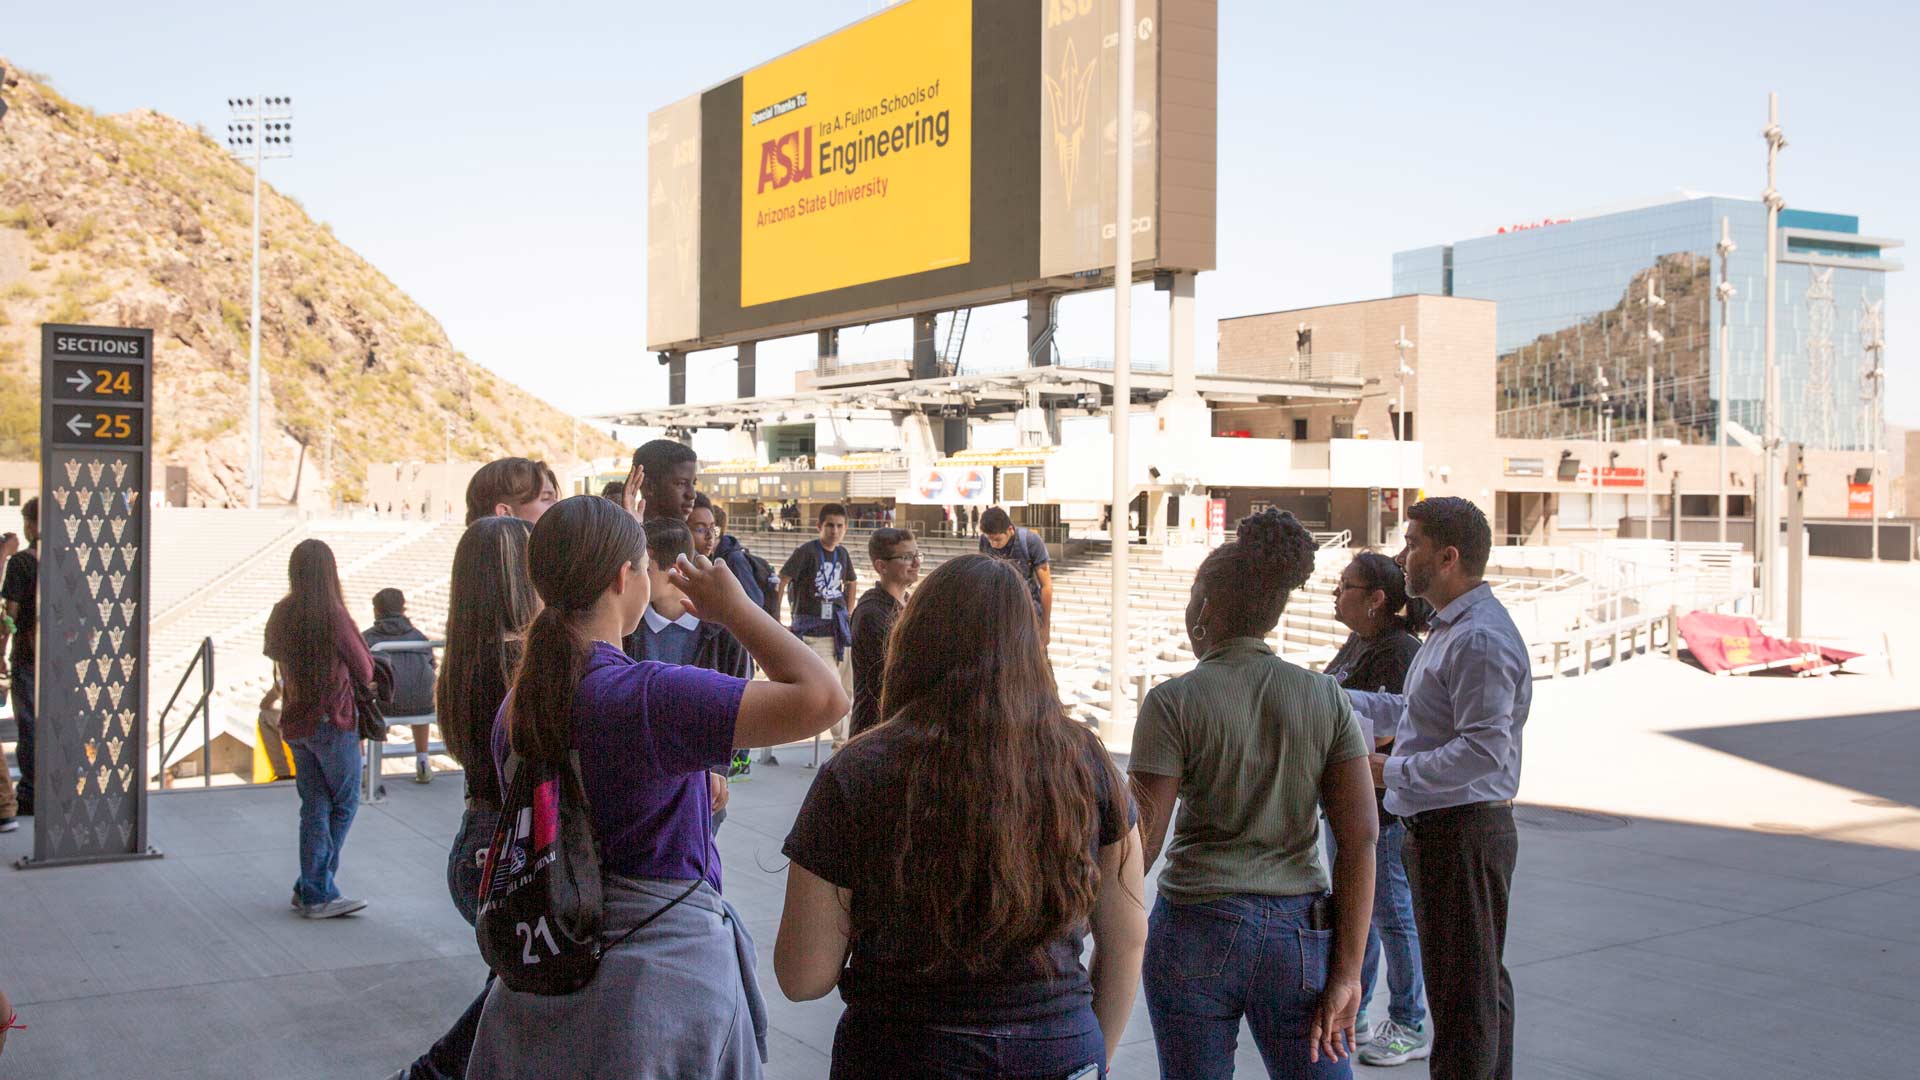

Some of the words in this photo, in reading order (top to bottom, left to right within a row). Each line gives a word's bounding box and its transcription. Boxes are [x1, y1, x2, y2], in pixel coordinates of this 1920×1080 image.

[820, 121, 831, 137] Ira
[834, 116, 844, 133] A.
[845, 105, 878, 128] Fulton
[880, 86, 926, 116] Schools
[927, 79, 940, 99] of
[757, 126, 813, 194] ASU
[820, 109, 950, 175] Engineering
[757, 204, 796, 228] Arizona
[798, 194, 827, 217] State
[829, 177, 889, 208] University
[57, 337, 139, 355] SECTIONS
[94, 369, 132, 395] 24
[93, 413, 132, 439] 25
[515, 915, 560, 965] 21
